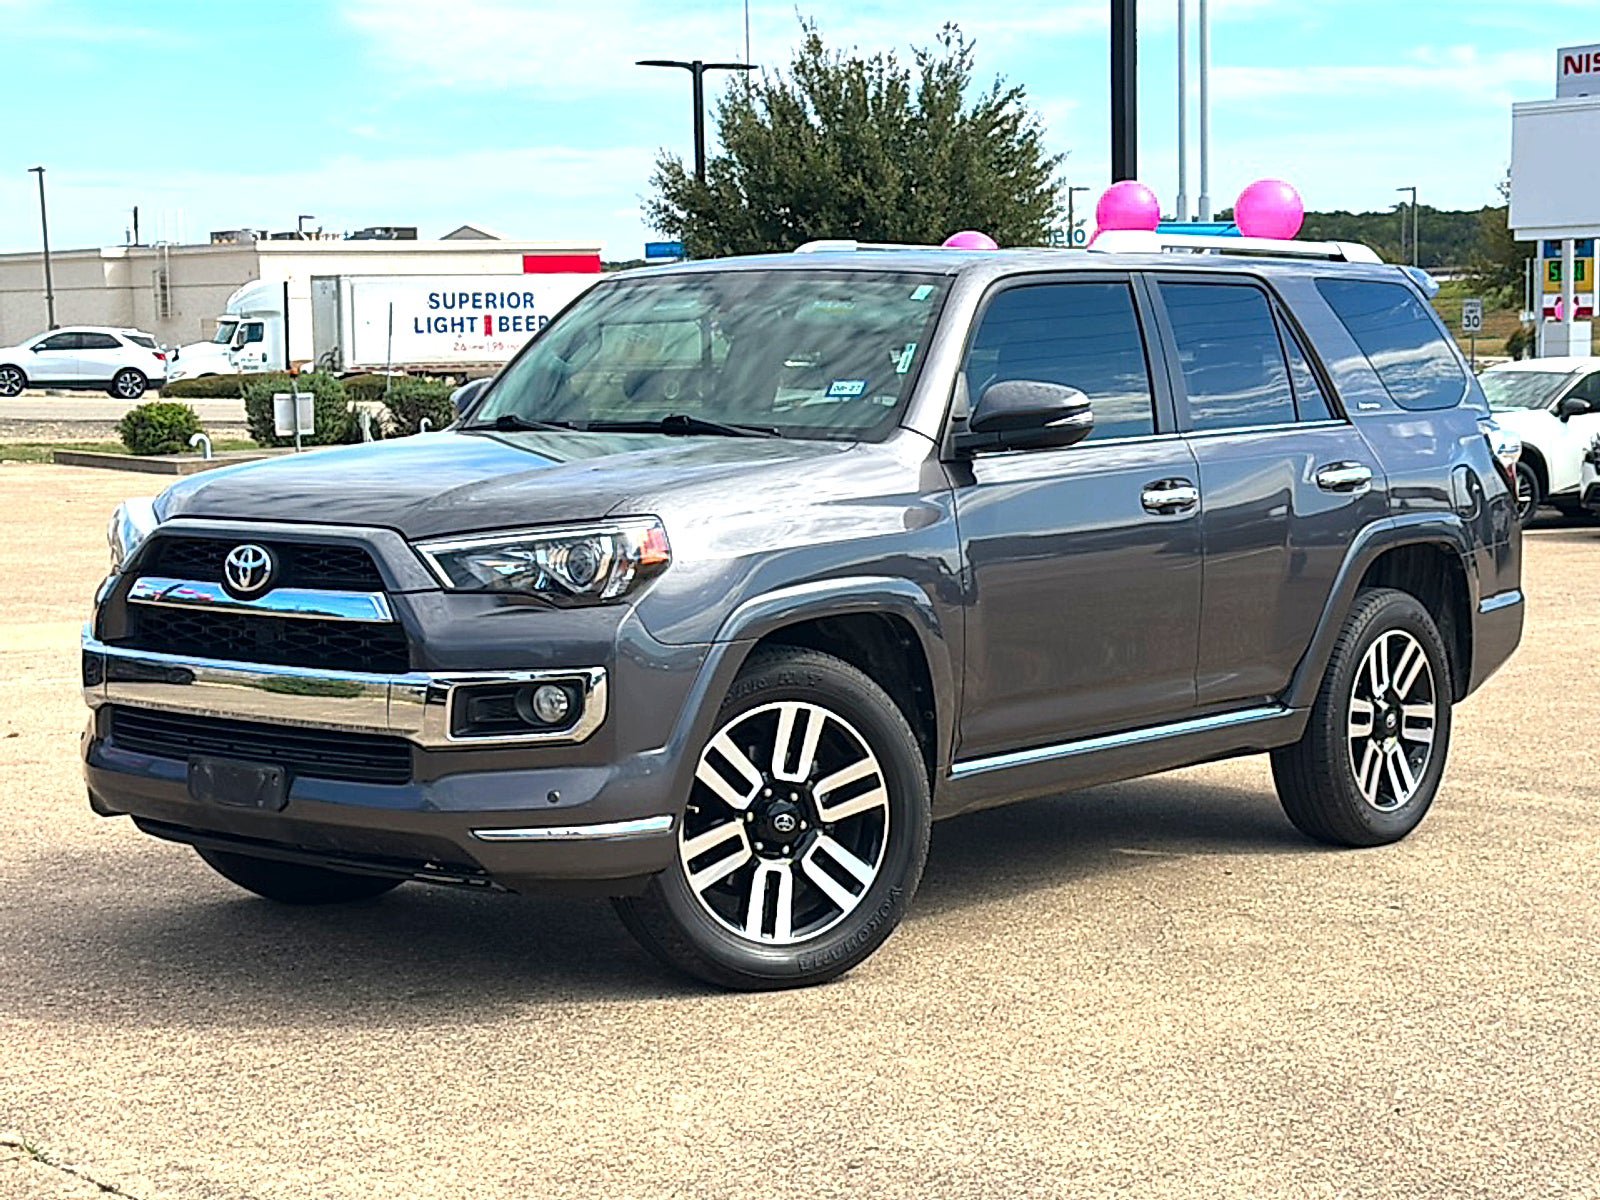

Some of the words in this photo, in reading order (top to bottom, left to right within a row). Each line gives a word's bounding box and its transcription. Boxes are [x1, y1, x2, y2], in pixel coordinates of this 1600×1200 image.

[428, 291, 535, 310] SUPERIOR
[413, 316, 479, 334] LIGHT
[1463, 315, 1480, 328] 30
